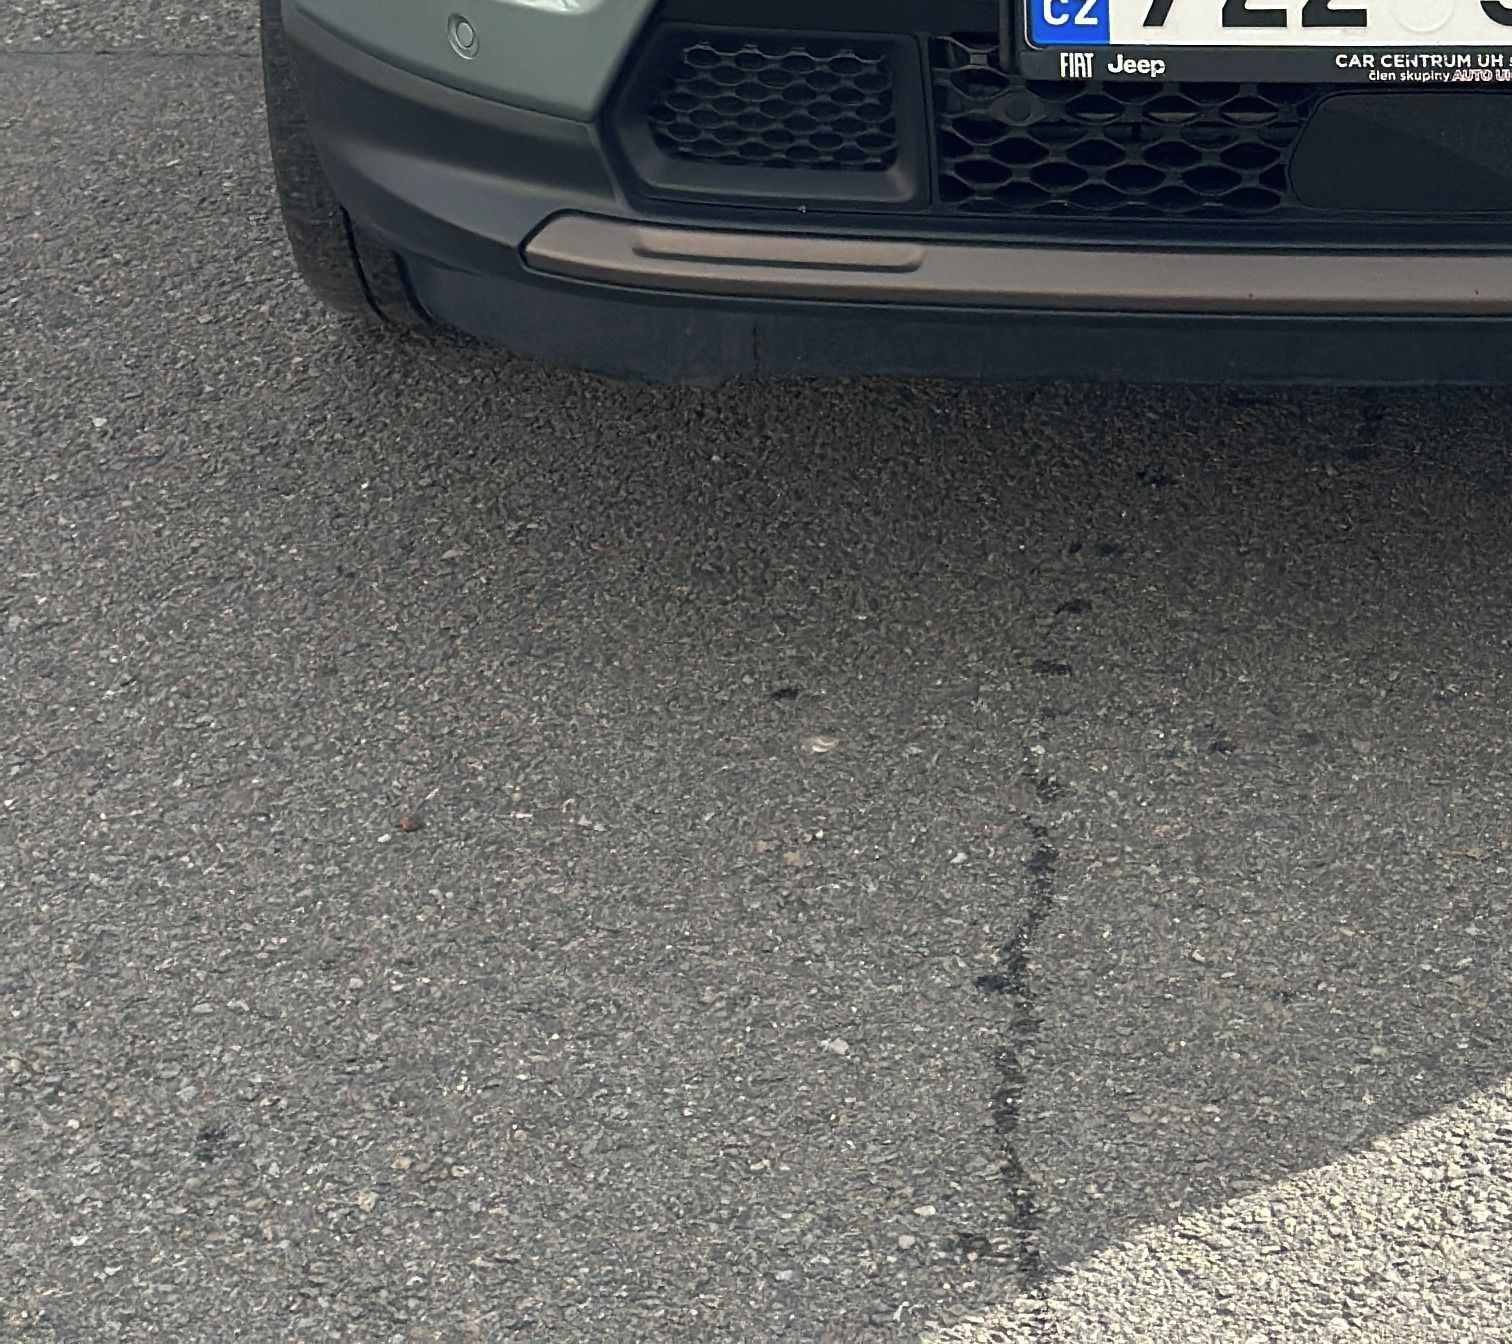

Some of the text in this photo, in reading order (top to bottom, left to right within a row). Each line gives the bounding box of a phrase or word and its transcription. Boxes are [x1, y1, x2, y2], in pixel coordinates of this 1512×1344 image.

[1060, 52, 1166, 78] FIAT Jeep
[1335, 54, 1375, 68] CAR
[1381, 54, 1471, 68] CENTRUM
[1477, 54, 1504, 68] UH
[1368, 70, 1396, 81] člen
[1400, 70, 1450, 83] skupiny
[1451, 69, 1492, 82] AUTO
